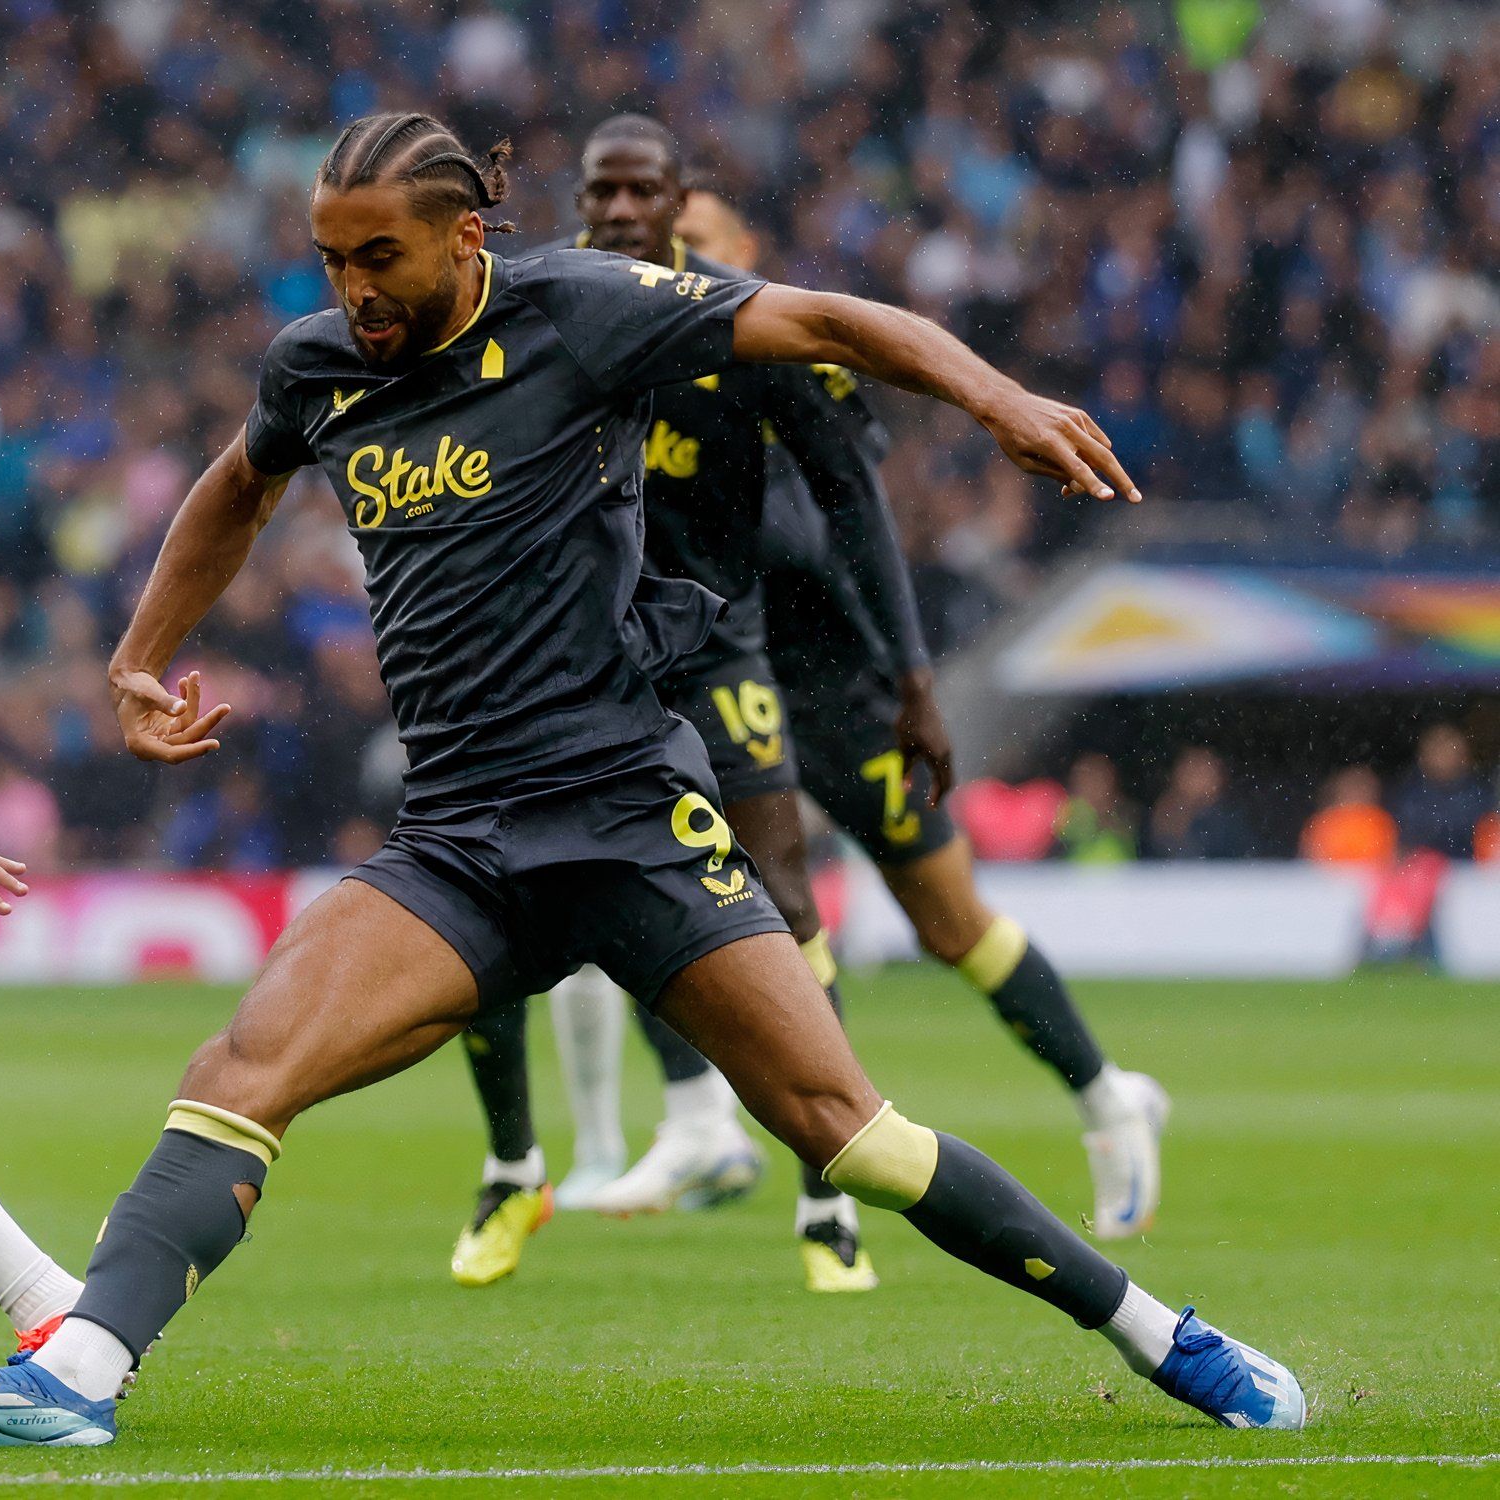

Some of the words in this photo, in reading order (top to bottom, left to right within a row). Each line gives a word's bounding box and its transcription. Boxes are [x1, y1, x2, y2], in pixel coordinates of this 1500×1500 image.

[347, 435, 492, 529] Stake
[405, 503, 434, 519] .com
[671, 791, 731, 873] 9
